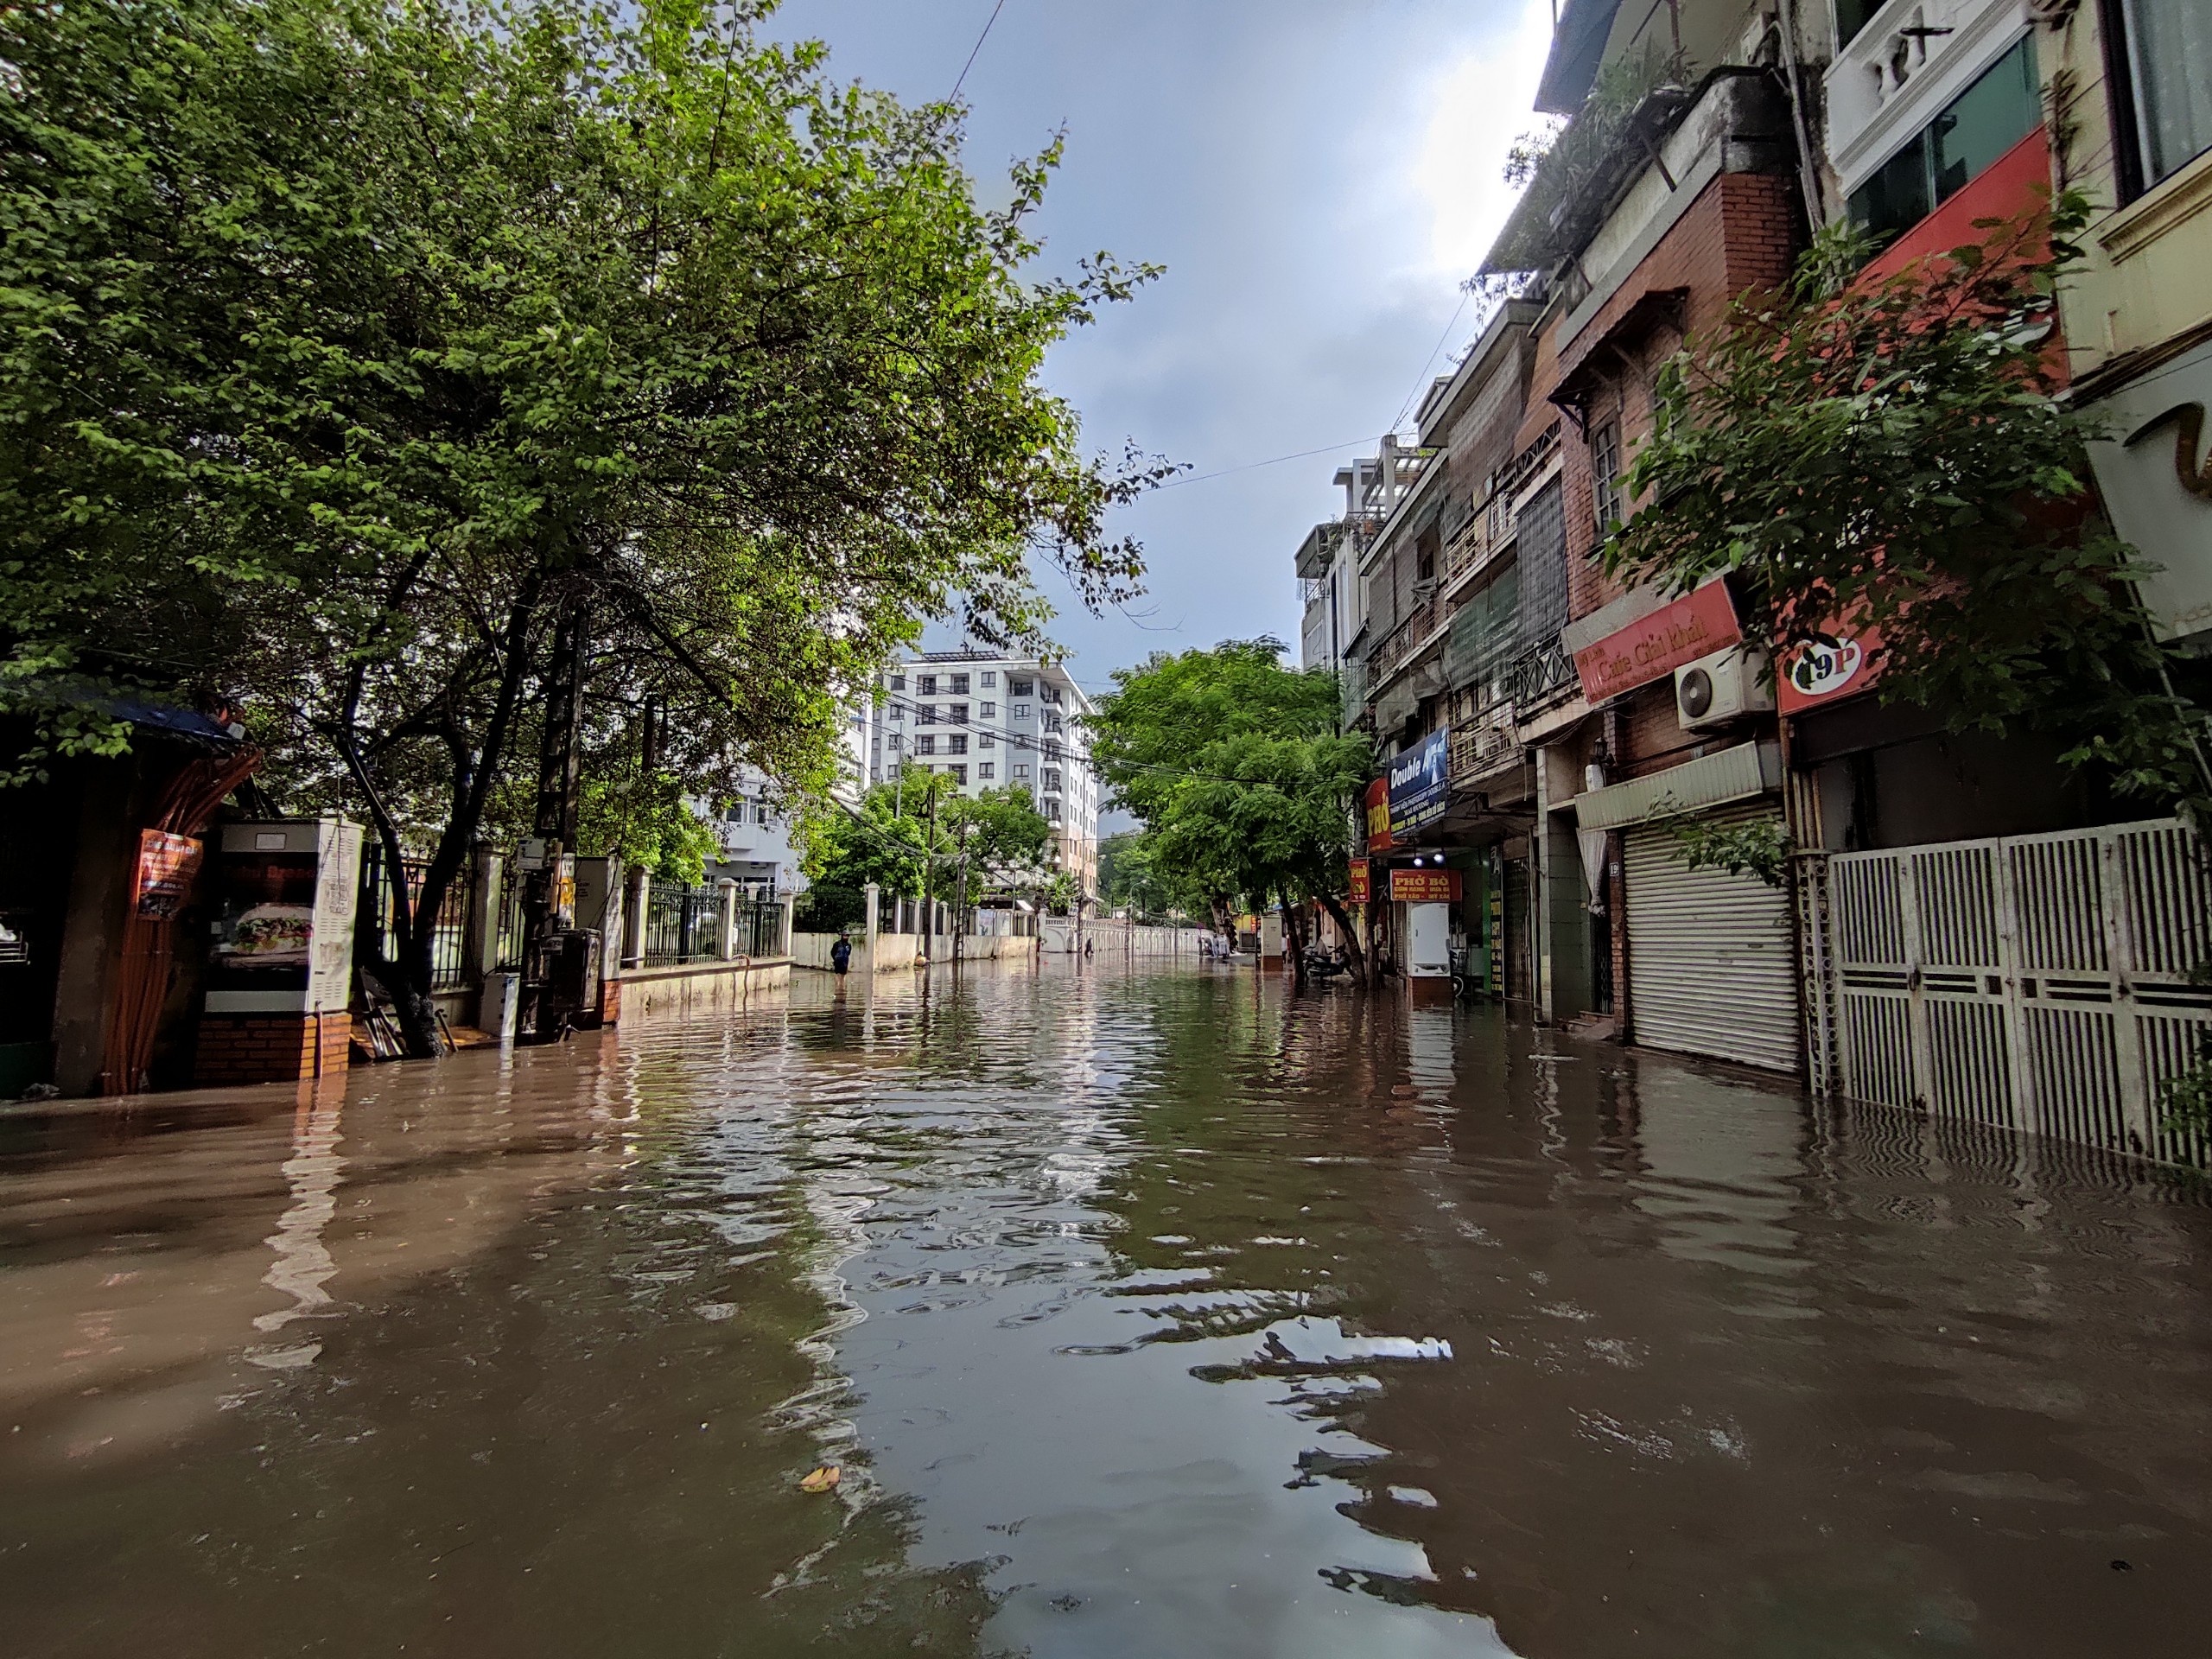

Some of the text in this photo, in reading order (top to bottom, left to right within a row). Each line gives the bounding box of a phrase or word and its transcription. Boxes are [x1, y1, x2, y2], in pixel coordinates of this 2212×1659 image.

[1391, 756, 1421, 790] Double
[1367, 791, 1389, 836] PHỞ
[1351, 865, 1367, 878] PHỞ
[1395, 874, 1448, 886] PHỞ BÒ
